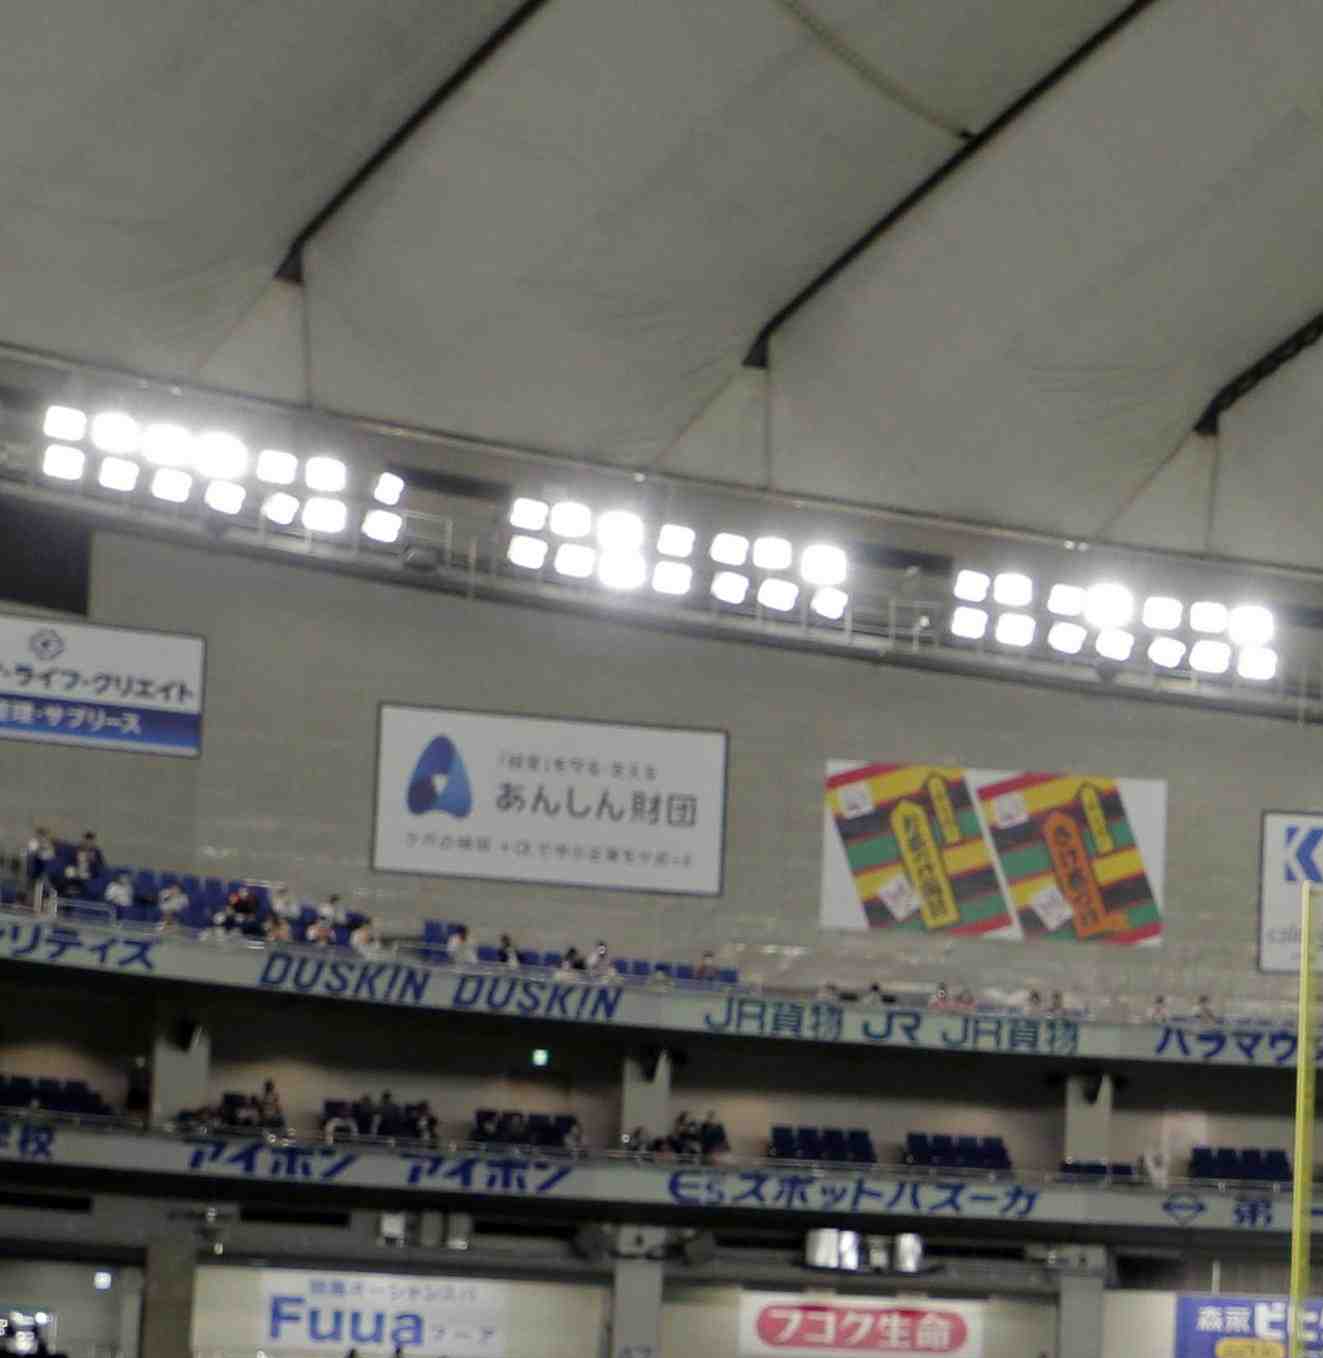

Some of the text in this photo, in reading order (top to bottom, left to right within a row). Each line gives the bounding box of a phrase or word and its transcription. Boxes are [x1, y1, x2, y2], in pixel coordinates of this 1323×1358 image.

[495, 782, 698, 828] あんしん財団
[258, 952, 624, 1020] DUSKIN DUSKIN
[704, 1000, 1080, 1053] JR貨物 JR JR貨物
[269, 1296, 425, 1345] Fuua
[768, 1307, 955, 1350] フコク生命
